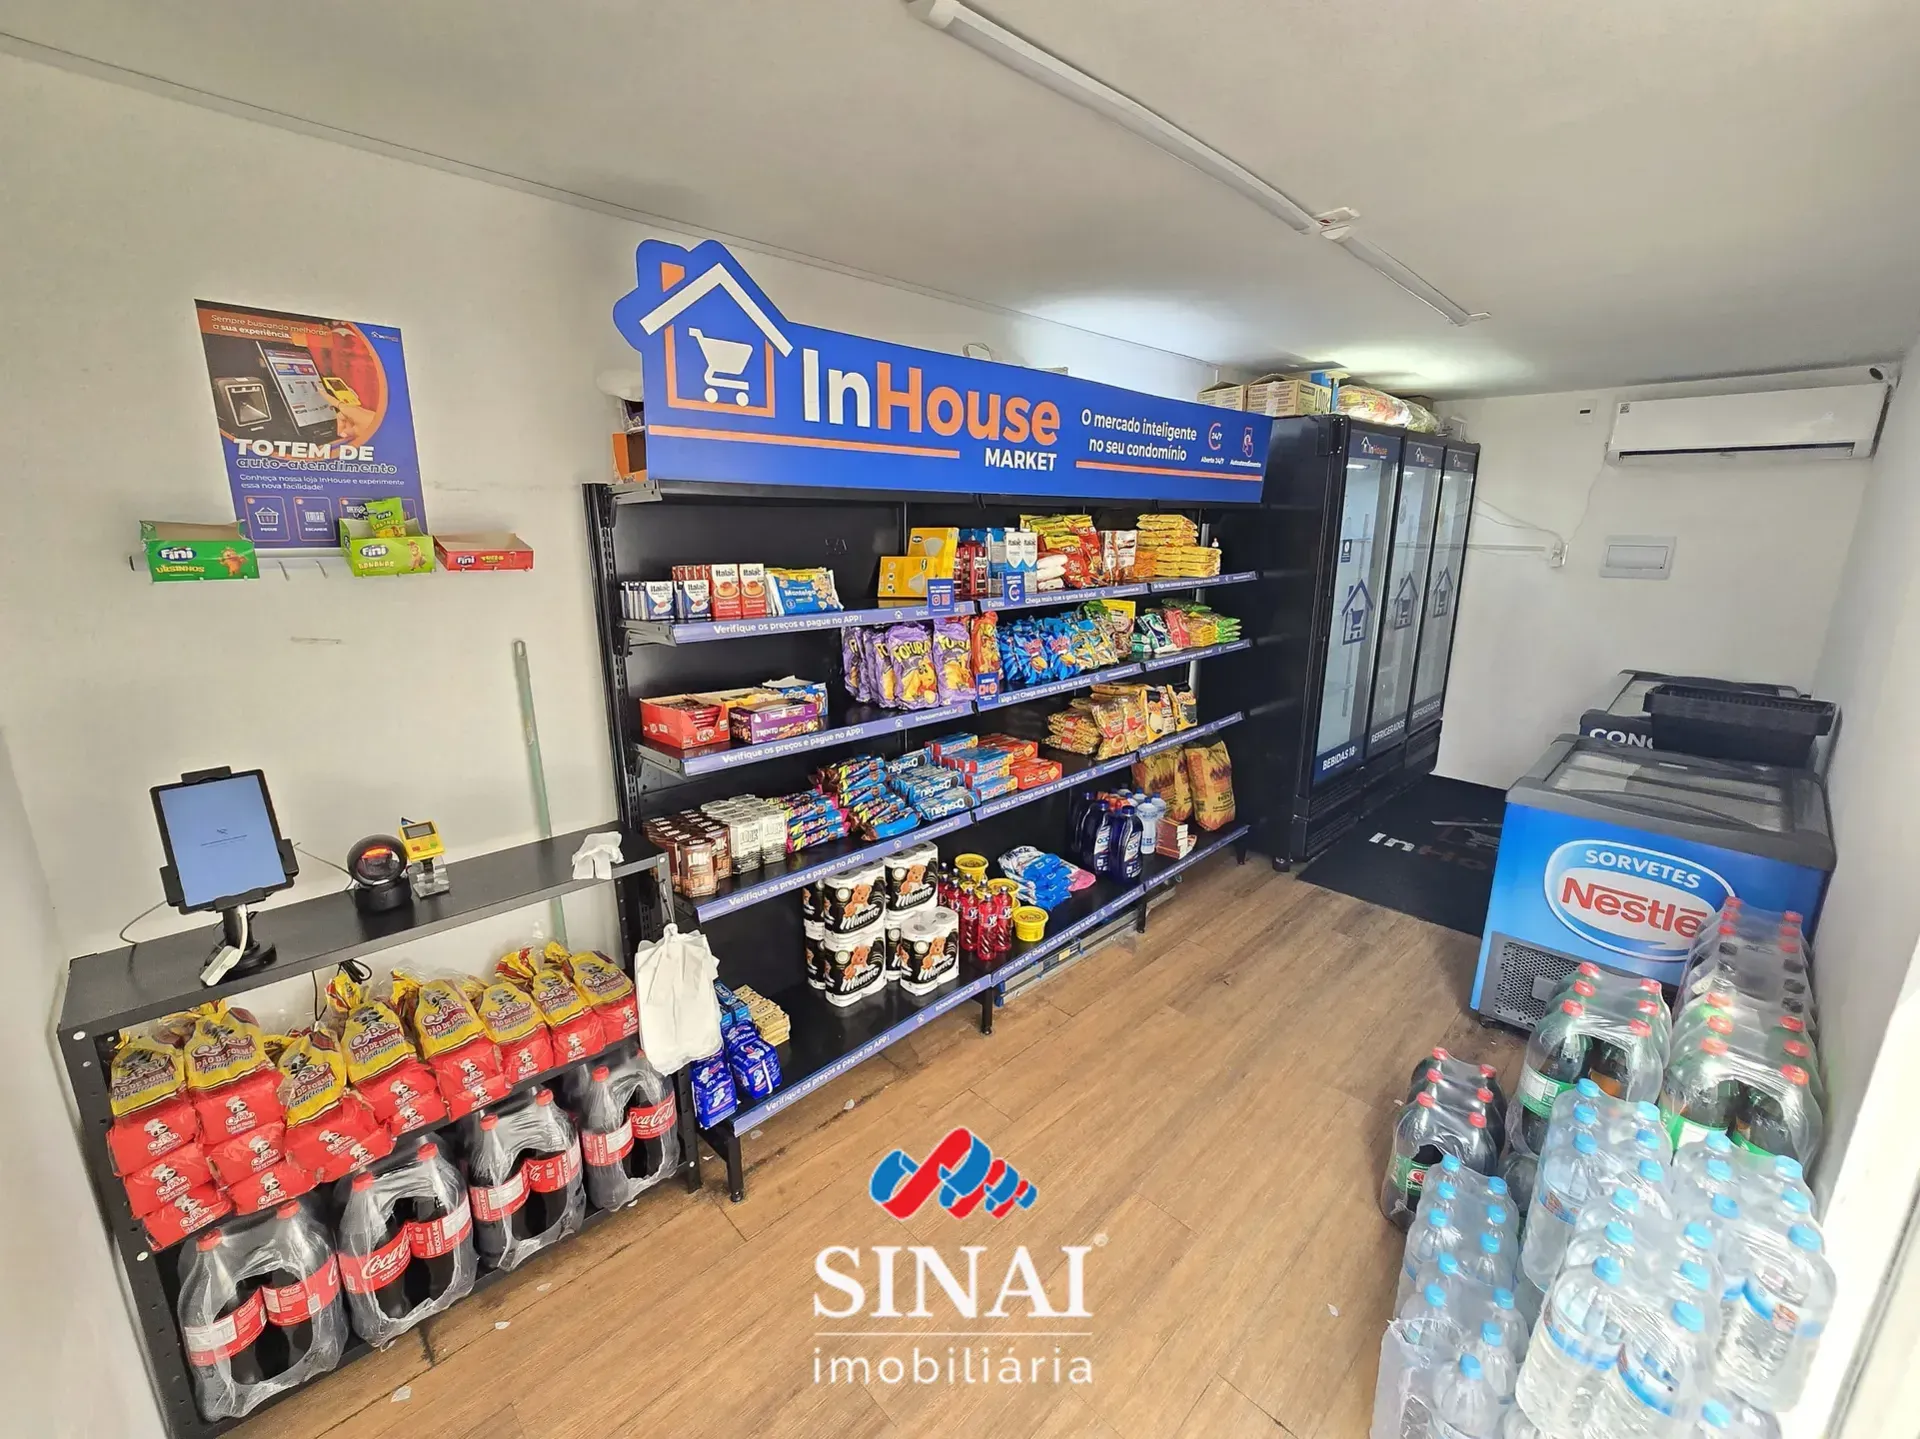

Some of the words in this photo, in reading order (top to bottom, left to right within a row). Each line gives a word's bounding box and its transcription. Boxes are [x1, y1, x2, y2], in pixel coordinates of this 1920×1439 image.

[211, 314, 245, 326] Sempre
[247, 319, 288, 331] buscando
[290, 325, 328, 337] melhorar
[239, 326, 291, 339] experiência.
[802, 347, 1061, 446] InHouse
[1081, 408, 1091, 426] O
[1094, 414, 1140, 433] mercado
[1142, 418, 1197, 441] inteligente
[233, 438, 337, 460] TOTEM
[339, 445, 375, 461] DE
[985, 448, 1057, 473] MARKET
[1089, 438, 1104, 452] no
[1105, 441, 1124, 455] seu
[1126, 441, 1187, 462] condomínio
[236, 457, 397, 475] auto-atendimento
[239, 473, 277, 483] Conheça
[279, 475, 302, 483] nossa
[303, 475, 318, 485] loja
[319, 476, 351, 485] InHouse
[358, 478, 405, 487] experimente
[283, 482, 324, 491] facilidade!
[161, 546, 194, 561] Fini
[361, 545, 387, 557] Fini
[457, 556, 475, 565] Fini
[155, 564, 205, 574] URSINHOS
[713, 622, 756, 635] Verifique
[758, 623, 769, 631] os
[770, 620, 798, 632] preços
[806, 617, 830, 630] pague
[832, 616, 842, 624] no
[843, 611, 863, 623] APP!
[1411, 699, 1441, 721] REFRIGERADOS
[755, 727, 779, 738] TRENTO
[1371, 718, 1406, 745] REFRIGERADOS
[721, 748, 762, 764] Verifique
[764, 747, 774, 756] os
[776, 740, 802, 754] preços
[810, 734, 834, 750] pague
[835, 733, 845, 741] no
[846, 727, 864, 738] APP!
[1322, 749, 1349, 771] BEBIDAS
[728, 886, 768, 906] Verifique
[770, 884, 779, 892] os
[780, 875, 805, 891] preços
[812, 864, 835, 880] pague
[836, 861, 846, 869] no
[847, 853, 865, 866] APP!
[1585, 849, 1702, 890] SORVETES
[896, 886, 933, 908] Mimmo
[1561, 877, 1708, 939] Nestlé
[840, 904, 880, 930] Mimmo
[840, 966, 880, 993] Mimmo
[918, 955, 954, 982] Mimmo
[227, 1045, 257, 1058] FORMA
[379, 1032, 405, 1049] FORMA
[143, 1066, 176, 1084] FORMA
[307, 1072, 335, 1091] FORMA
[765, 1086, 801, 1112] Verifique
[802, 1082, 812, 1092] os
[813, 1069, 836, 1089] preços
[843, 1051, 864, 1070] pague
[865, 1044, 873, 1054] no
